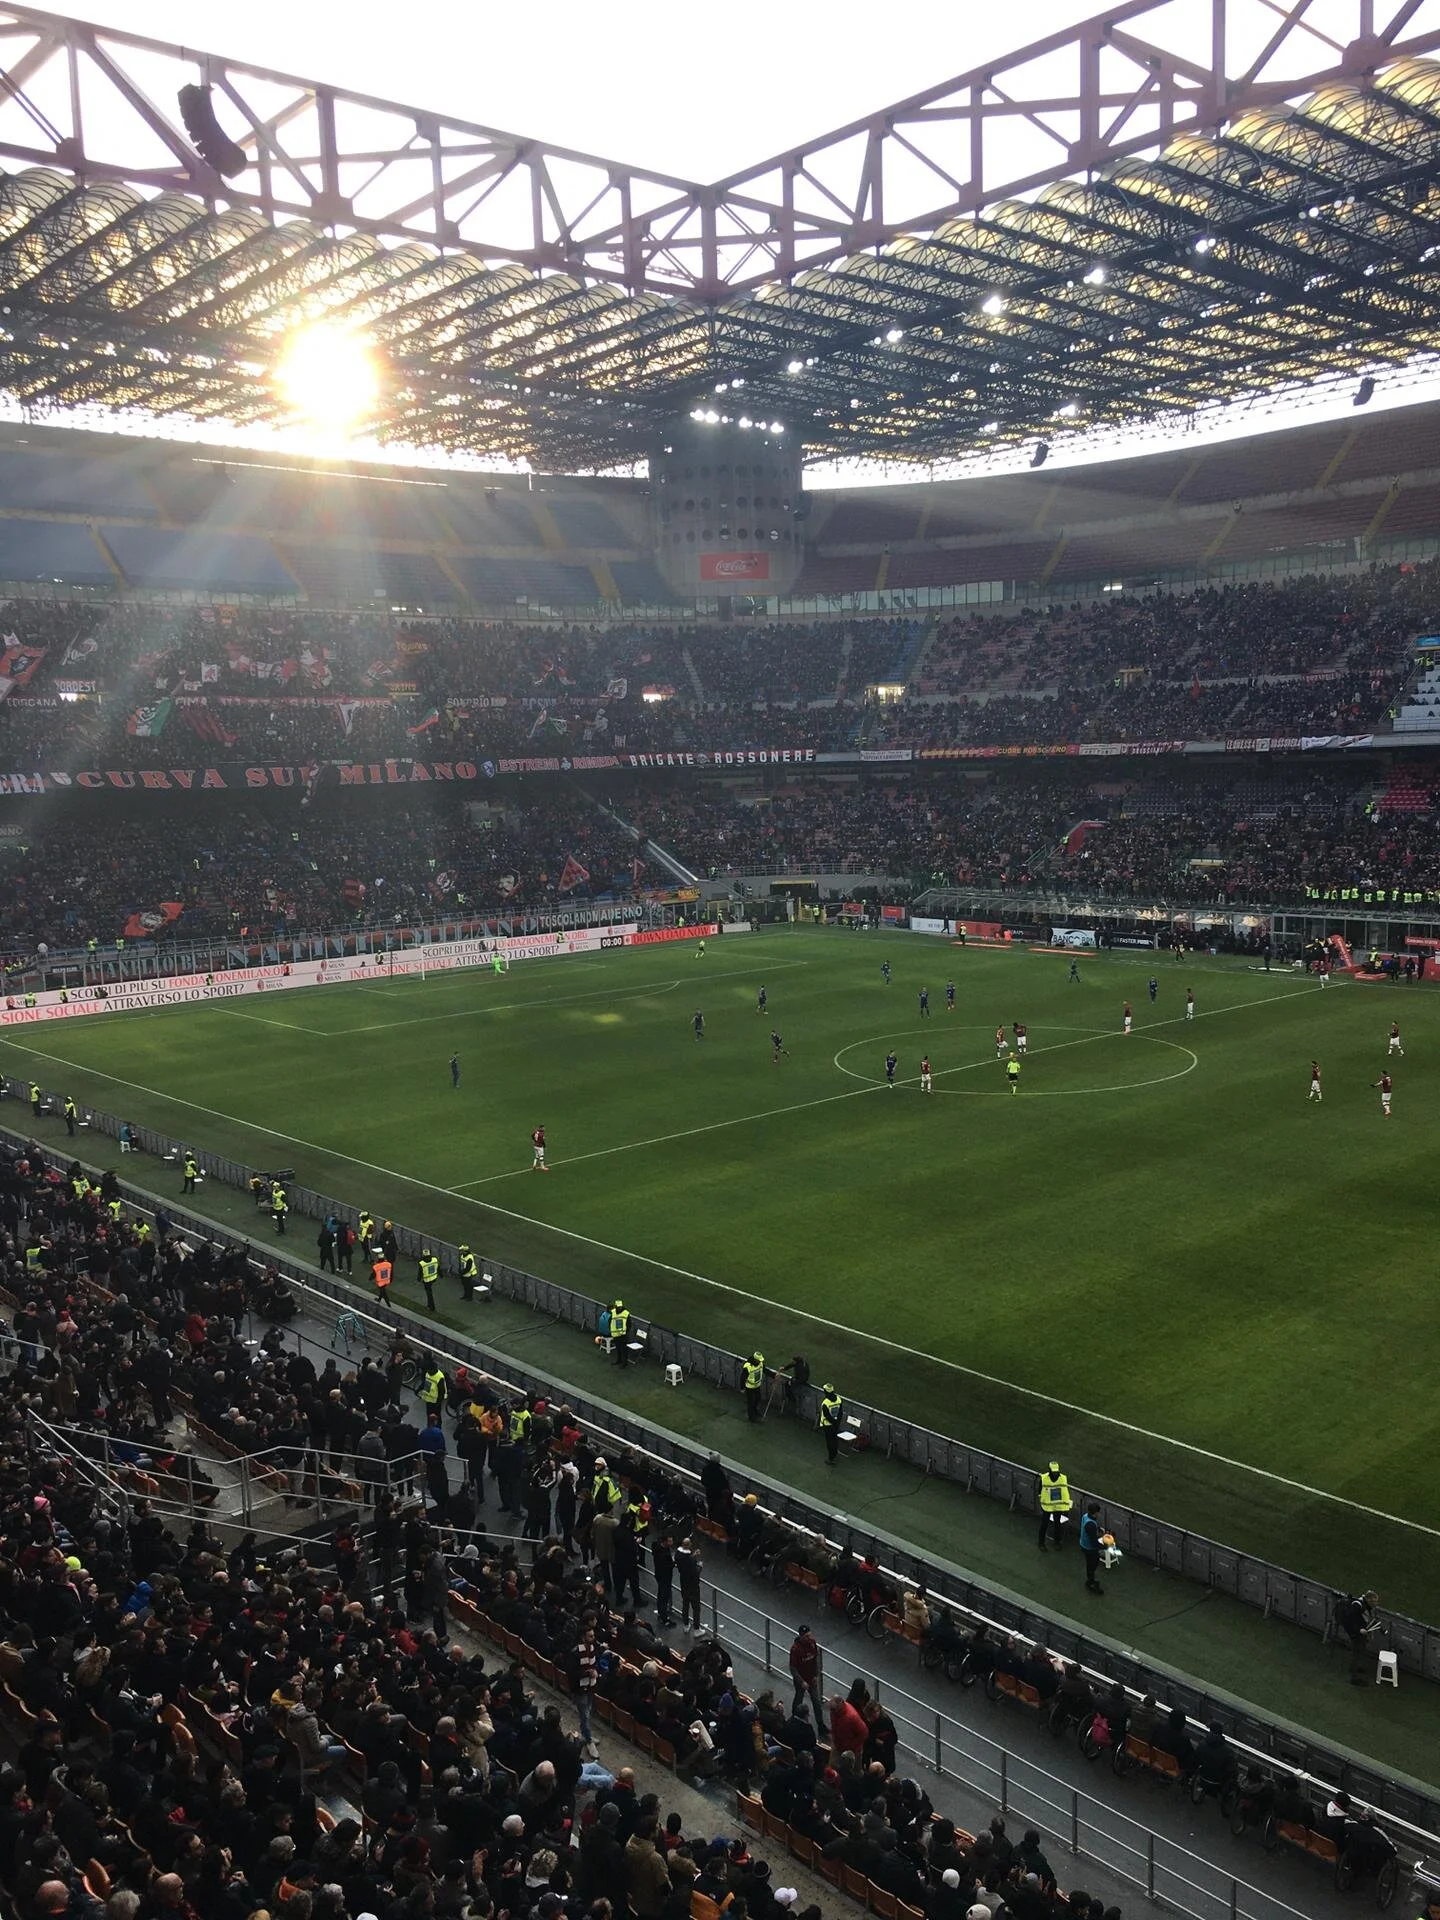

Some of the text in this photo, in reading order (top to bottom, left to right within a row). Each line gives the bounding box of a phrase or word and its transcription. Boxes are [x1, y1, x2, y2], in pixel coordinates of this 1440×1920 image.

[629, 749, 814, 767] BRIGATE ROSSONERE
[76, 768, 229, 789] CURVA
[337, 761, 478, 785] MILANO
[422, 944, 453, 957] SCOPRI
[455, 943, 463, 954] DI
[602, 937, 622, 948] 00:00
[350, 964, 410, 980] INCLUSIONE
[514, 949, 526, 959] LO
[115, 984, 126, 995] DI
[152, 979, 166, 990] SU
[169, 966, 294, 988] FONDAONEMILAN.OR
[46, 1001, 101, 1019] SOCIALE
[104, 990, 182, 1012] ATTRAVERSO
[184, 990, 200, 1001] LO
[202, 983, 245, 997] SPORT?
